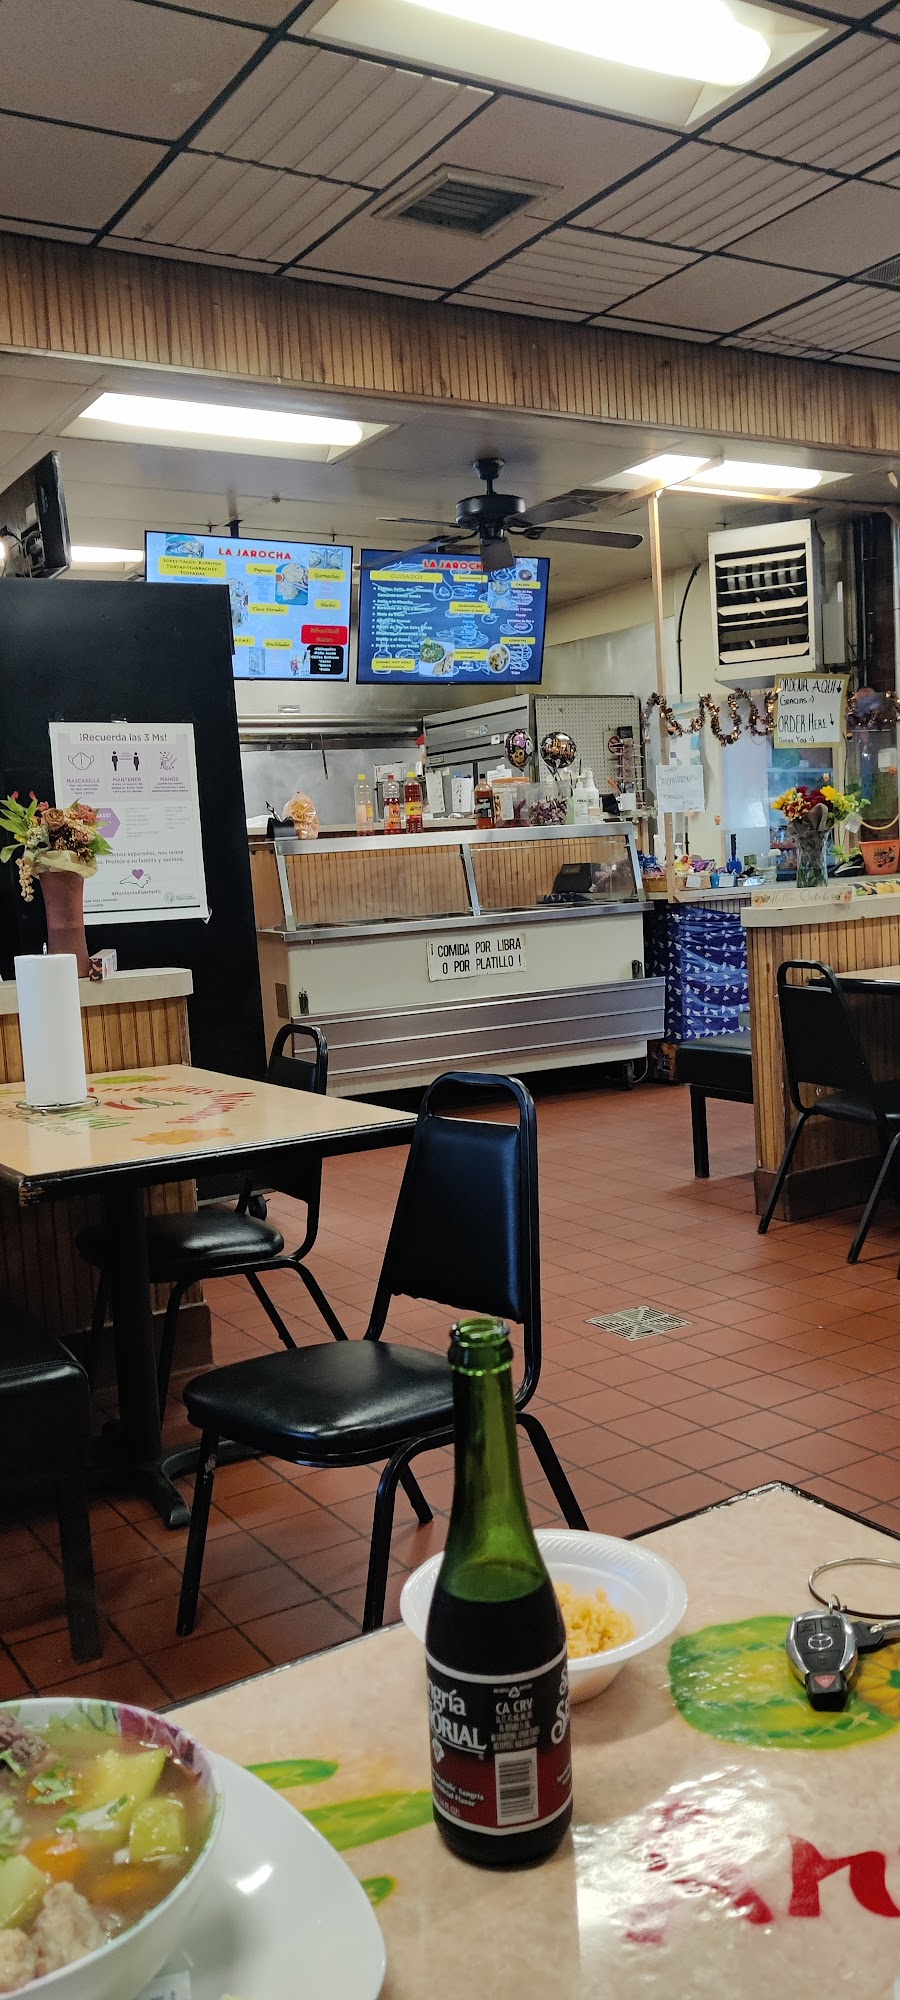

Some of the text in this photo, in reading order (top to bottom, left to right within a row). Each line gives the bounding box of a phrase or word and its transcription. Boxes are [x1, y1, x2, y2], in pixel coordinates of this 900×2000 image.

[218, 547, 292, 560] LA JAROCHA
[423, 560, 483, 570] LA JAROCH
[778, 714, 807, 734] ORDER
[79, 733, 168, 742] ¡Recuerda las 3 Ms!
[437, 943, 470, 957] COMIDA
[475, 940, 491, 954] POR
[497, 937, 522, 952] LIBRA
[442, 962, 448, 974] O
[454, 959, 470, 973] POR
[476, 955, 514, 970] PLATILLO
[428, 1679, 467, 1716] ngría
[495, 1697, 534, 1715] CA CRV
[431, 1708, 487, 1751] ORIAL
